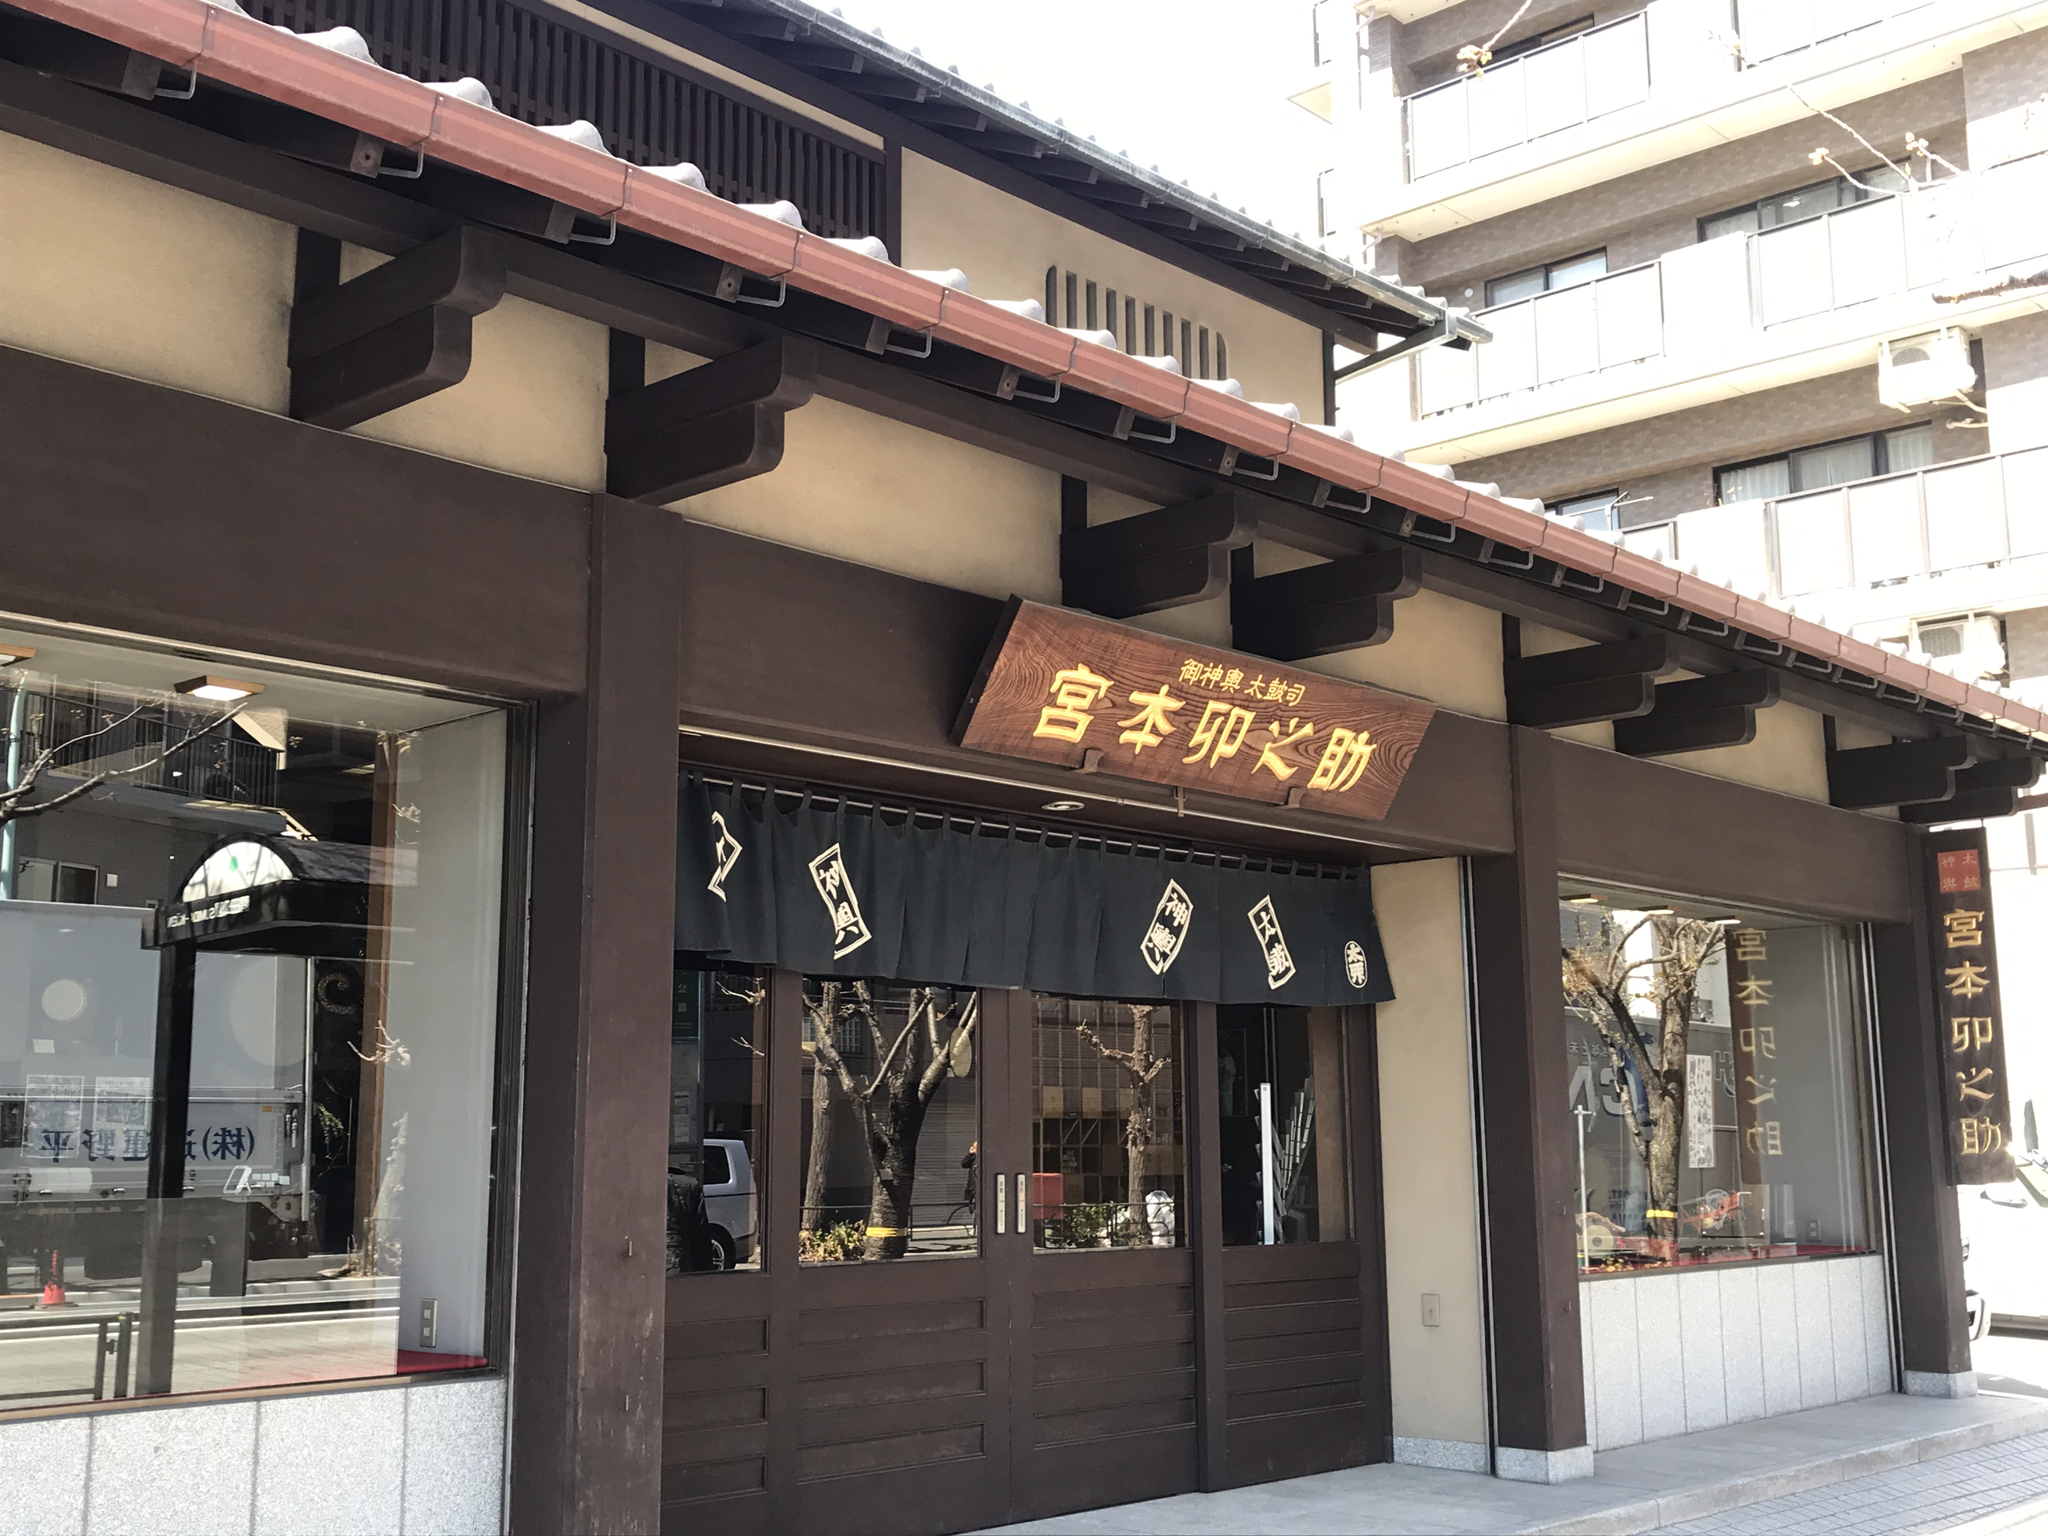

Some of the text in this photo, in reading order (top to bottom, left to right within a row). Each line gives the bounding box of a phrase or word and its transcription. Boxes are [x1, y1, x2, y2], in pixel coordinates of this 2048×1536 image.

[1033, 663, 1377, 792] 宮本卯之助
[1943, 908, 2002, 1156] 宮本卯之助
